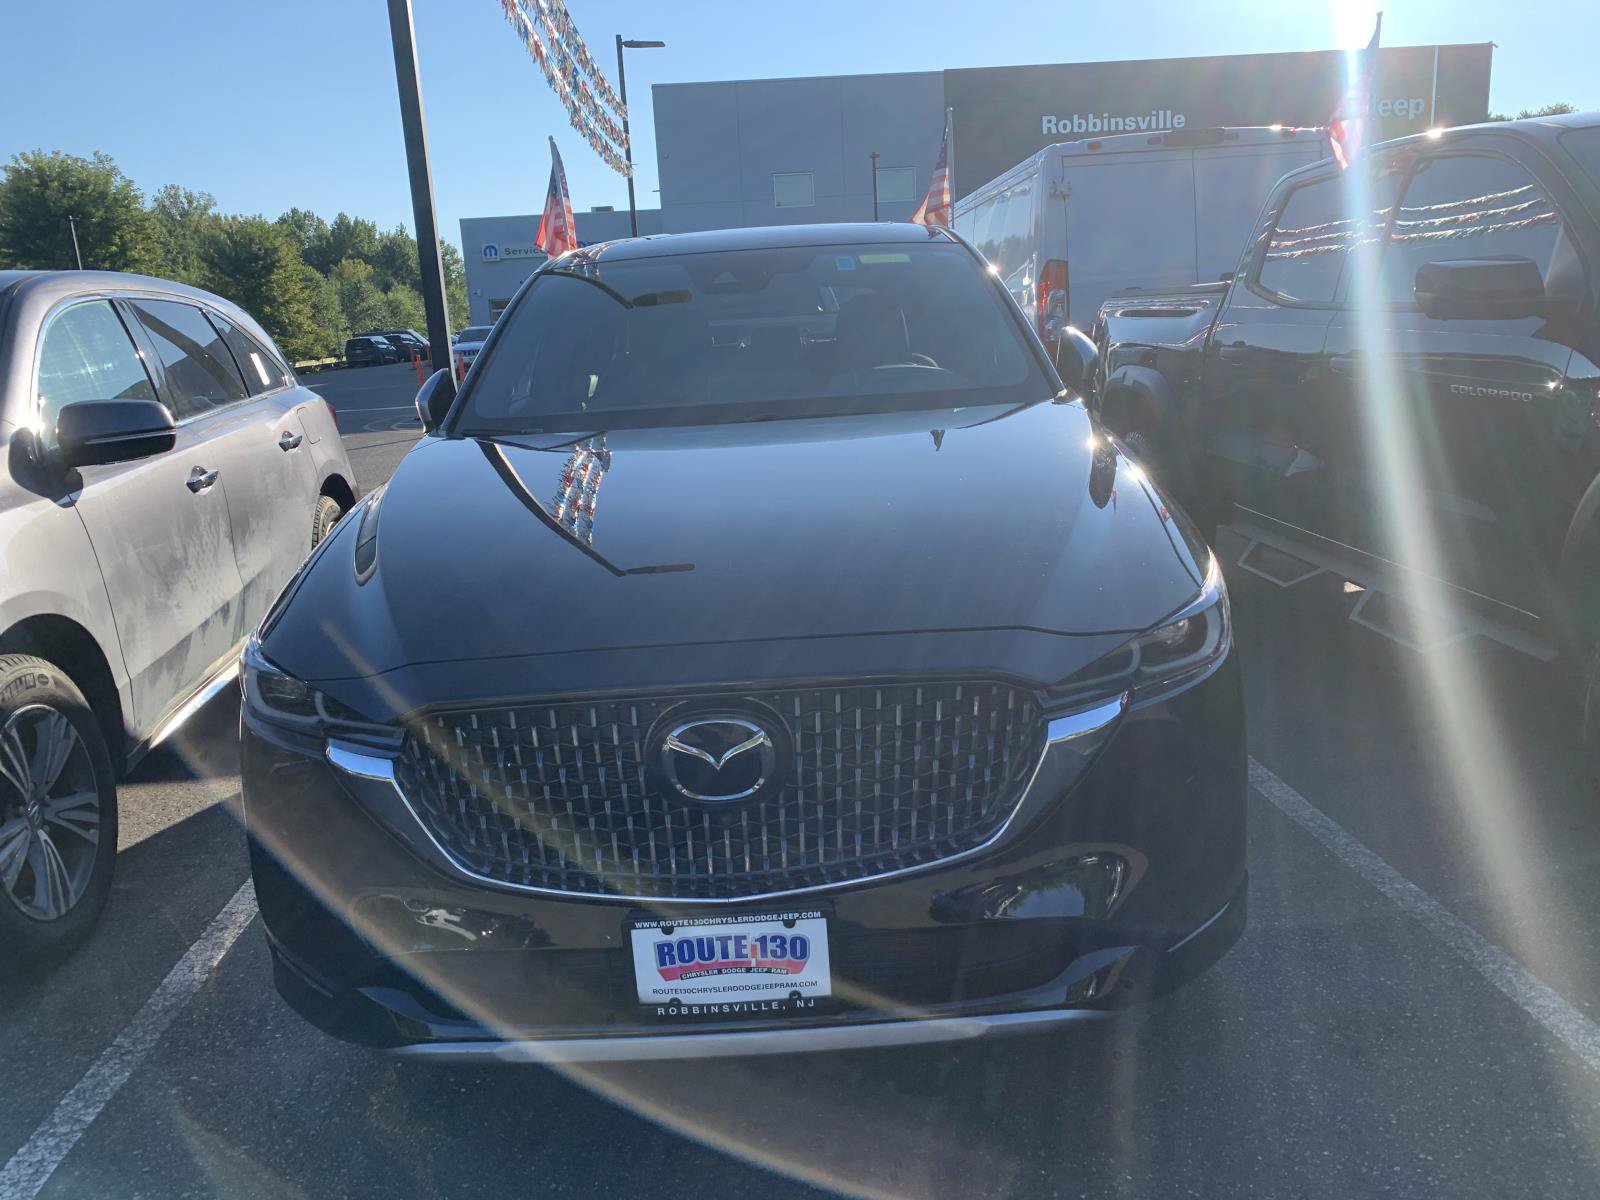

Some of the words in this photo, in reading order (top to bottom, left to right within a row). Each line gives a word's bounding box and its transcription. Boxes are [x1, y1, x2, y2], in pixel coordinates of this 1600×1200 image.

[1041, 110, 1186, 135] Robbinsville
[1450, 384, 1533, 402] COLORADO
[634, 911, 821, 929] WWW.ROUTE130CHRYSLERDODGEJEEP.COM
[656, 935, 749, 967] ROUTE
[754, 935, 808, 960] 130
[681, 969, 718, 980] CHRYSLER
[721, 967, 747, 975] DODGE
[652, 980, 818, 995] ROUTE130CHRYSLERDODGEJEEPRAM.COM
[657, 1001, 787, 1016] ROBBINSVILLE,
[796, 999, 815, 1008] NJ
